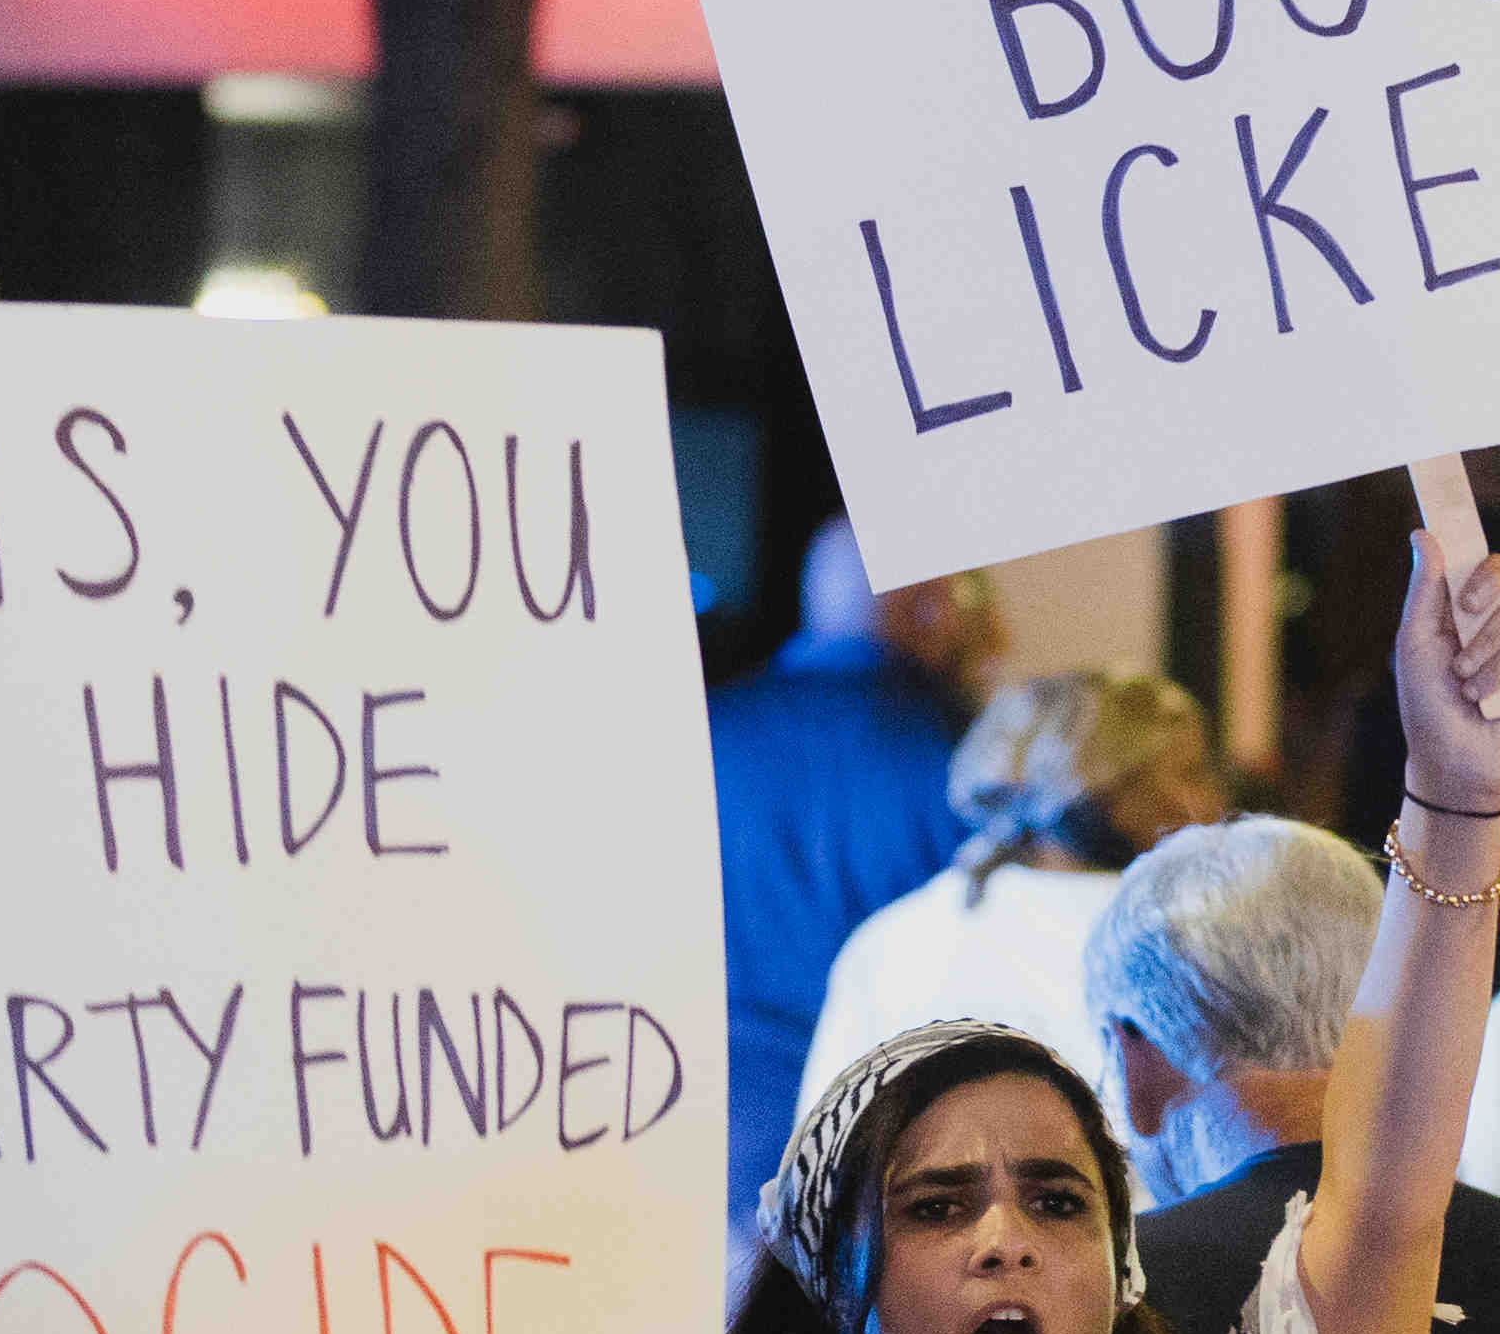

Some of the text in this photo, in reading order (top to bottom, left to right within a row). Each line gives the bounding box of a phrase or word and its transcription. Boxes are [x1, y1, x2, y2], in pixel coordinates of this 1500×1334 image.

[282, 411, 597, 624] YOU
[83, 674, 449, 873] HIDE
[290, 980, 683, 1157] FUNDED
